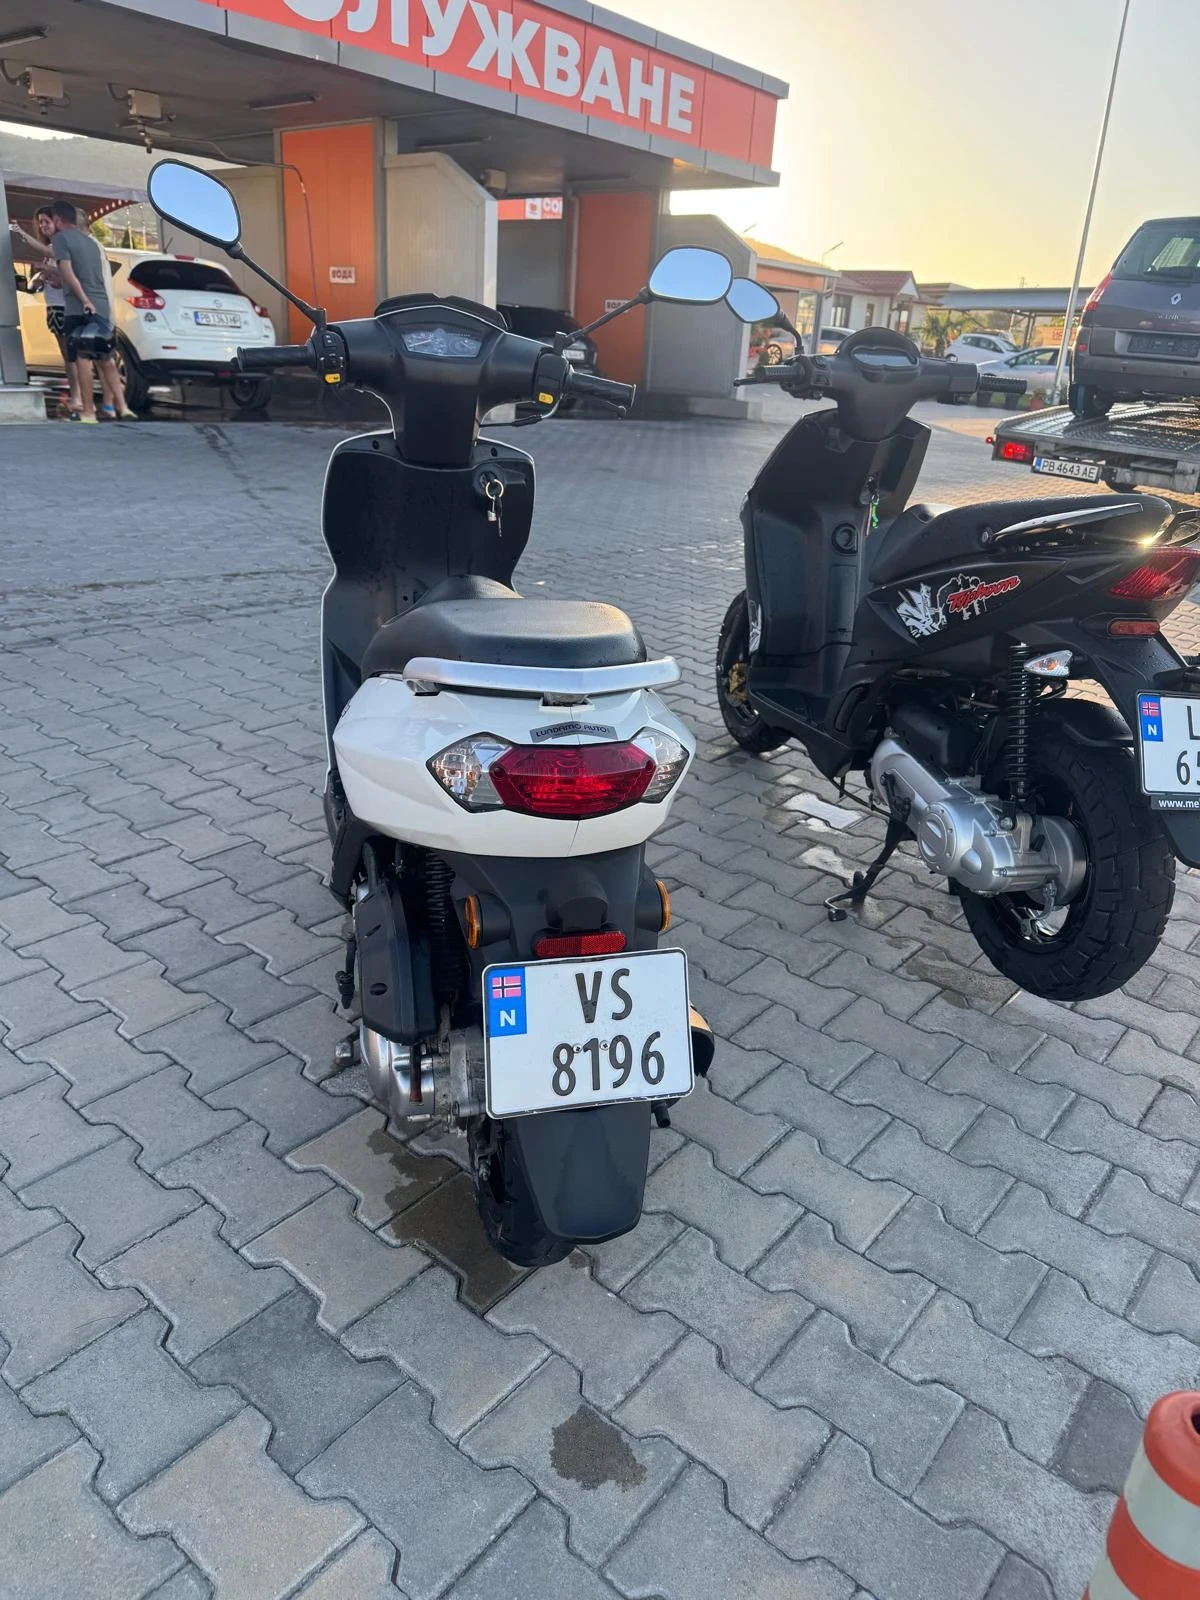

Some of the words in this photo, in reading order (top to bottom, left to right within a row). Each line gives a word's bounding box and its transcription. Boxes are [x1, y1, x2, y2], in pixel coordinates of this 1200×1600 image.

[283, 0, 696, 135] ЛУЖВАНЕ
[1042, 460, 1055, 471] PB
[1057, 463, 1081, 476] 4643
[1081, 467, 1096, 479] AE
[536, 723, 582, 737] LUNDAMO
[584, 724, 607, 733] AUTO
[1148, 724, 1158, 736] N
[1176, 750, 1200, 786] 6
[1159, 799, 1200, 809] www.me
[575, 968, 633, 1023] VS
[500, 1009, 516, 1027] N
[552, 1031, 665, 1097] 8196
